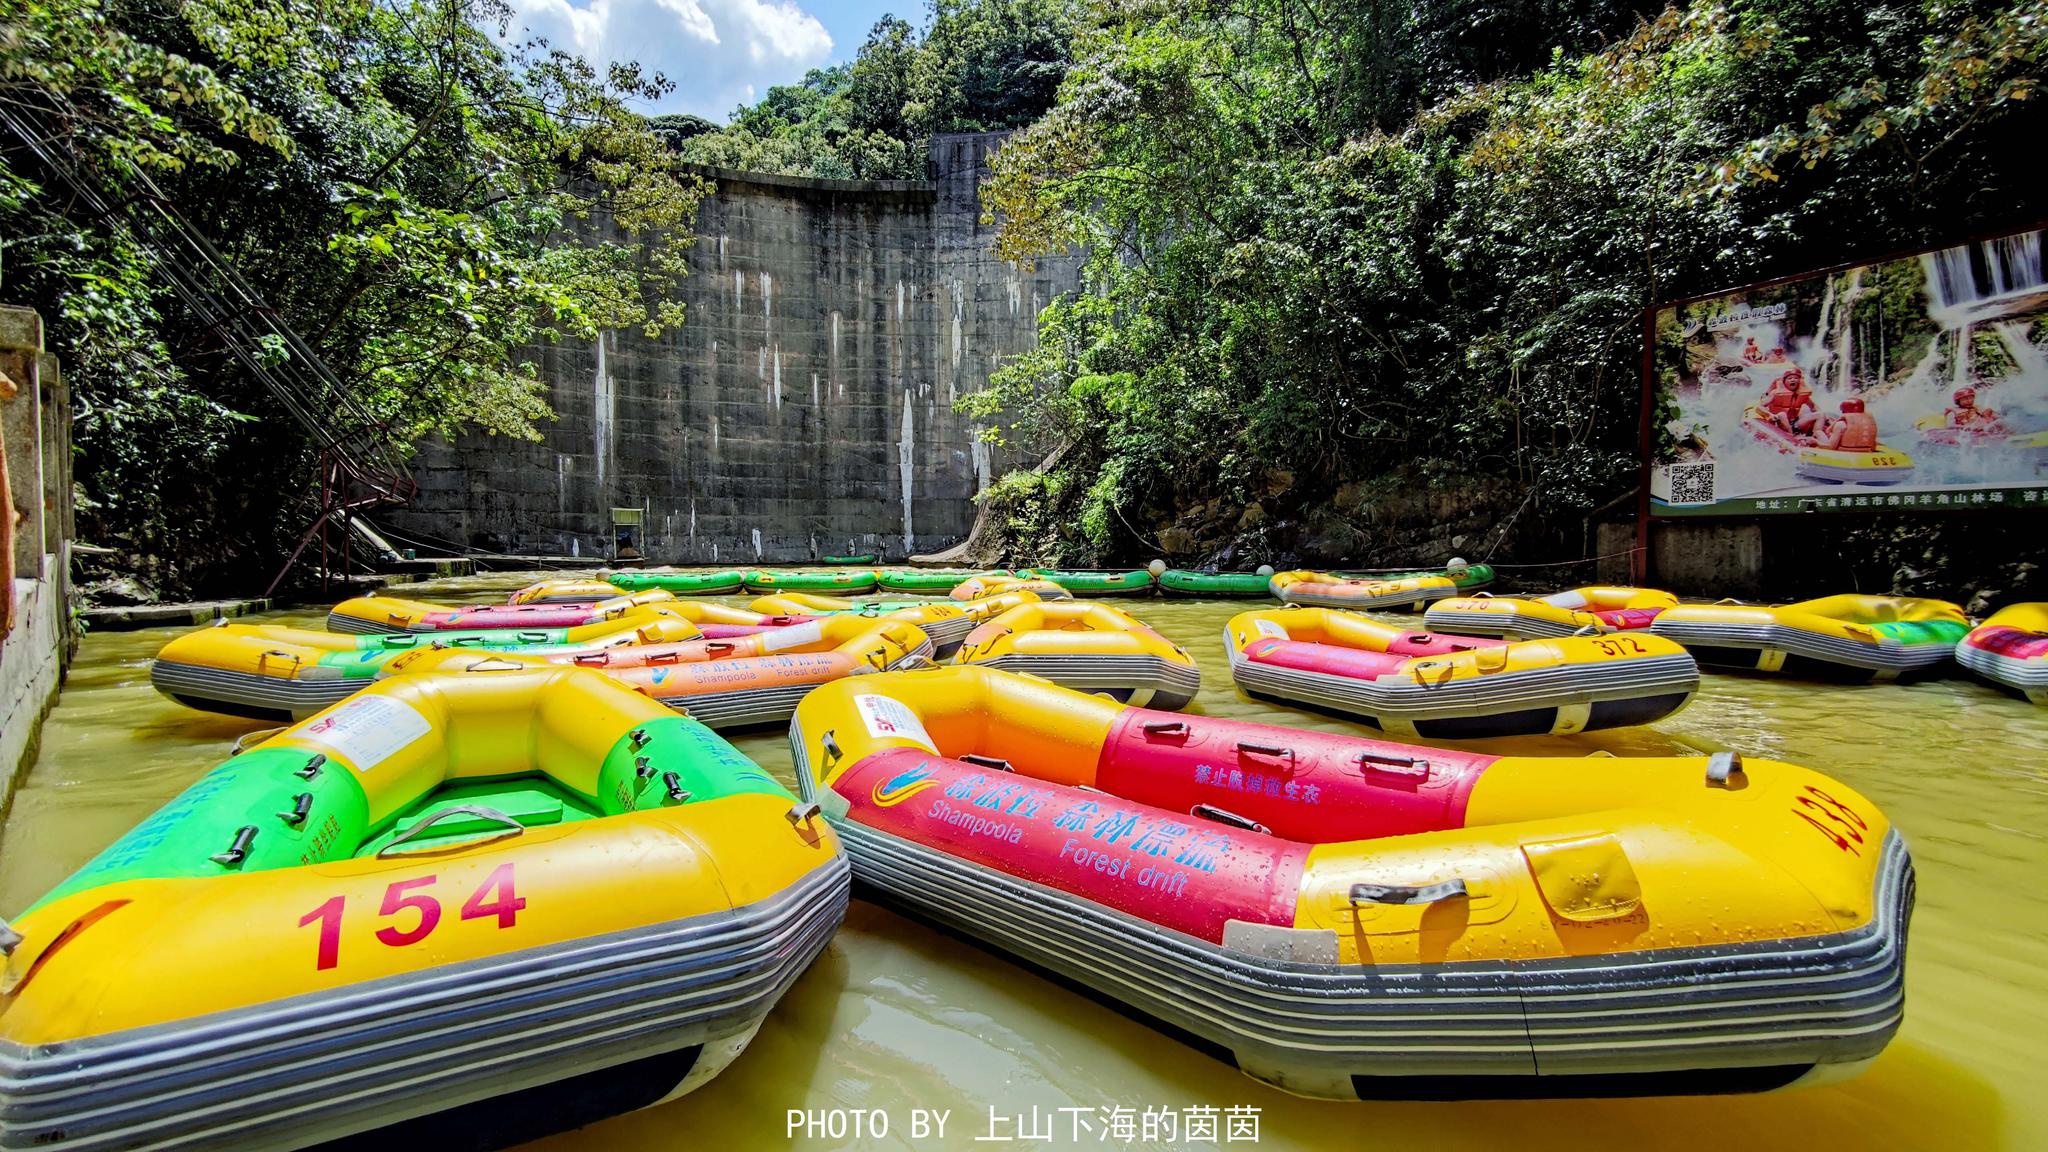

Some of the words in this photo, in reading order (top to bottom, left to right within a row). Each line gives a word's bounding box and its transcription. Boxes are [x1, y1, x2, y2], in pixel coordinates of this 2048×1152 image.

[695, 671, 757, 684] Shampoola
[776, 667, 808, 677] Forest
[811, 665, 831, 675] drift
[1591, 637, 1648, 656] 372
[927, 799, 1023, 844] Shampoola
[1059, 838, 1131, 880] Forest
[1137, 863, 1189, 897] drift
[945, 773, 1054, 820] 森波拉
[1052, 799, 1232, 873] 森林漂流
[1791, 785, 1868, 857] 438
[298, 862, 527, 971] 154
